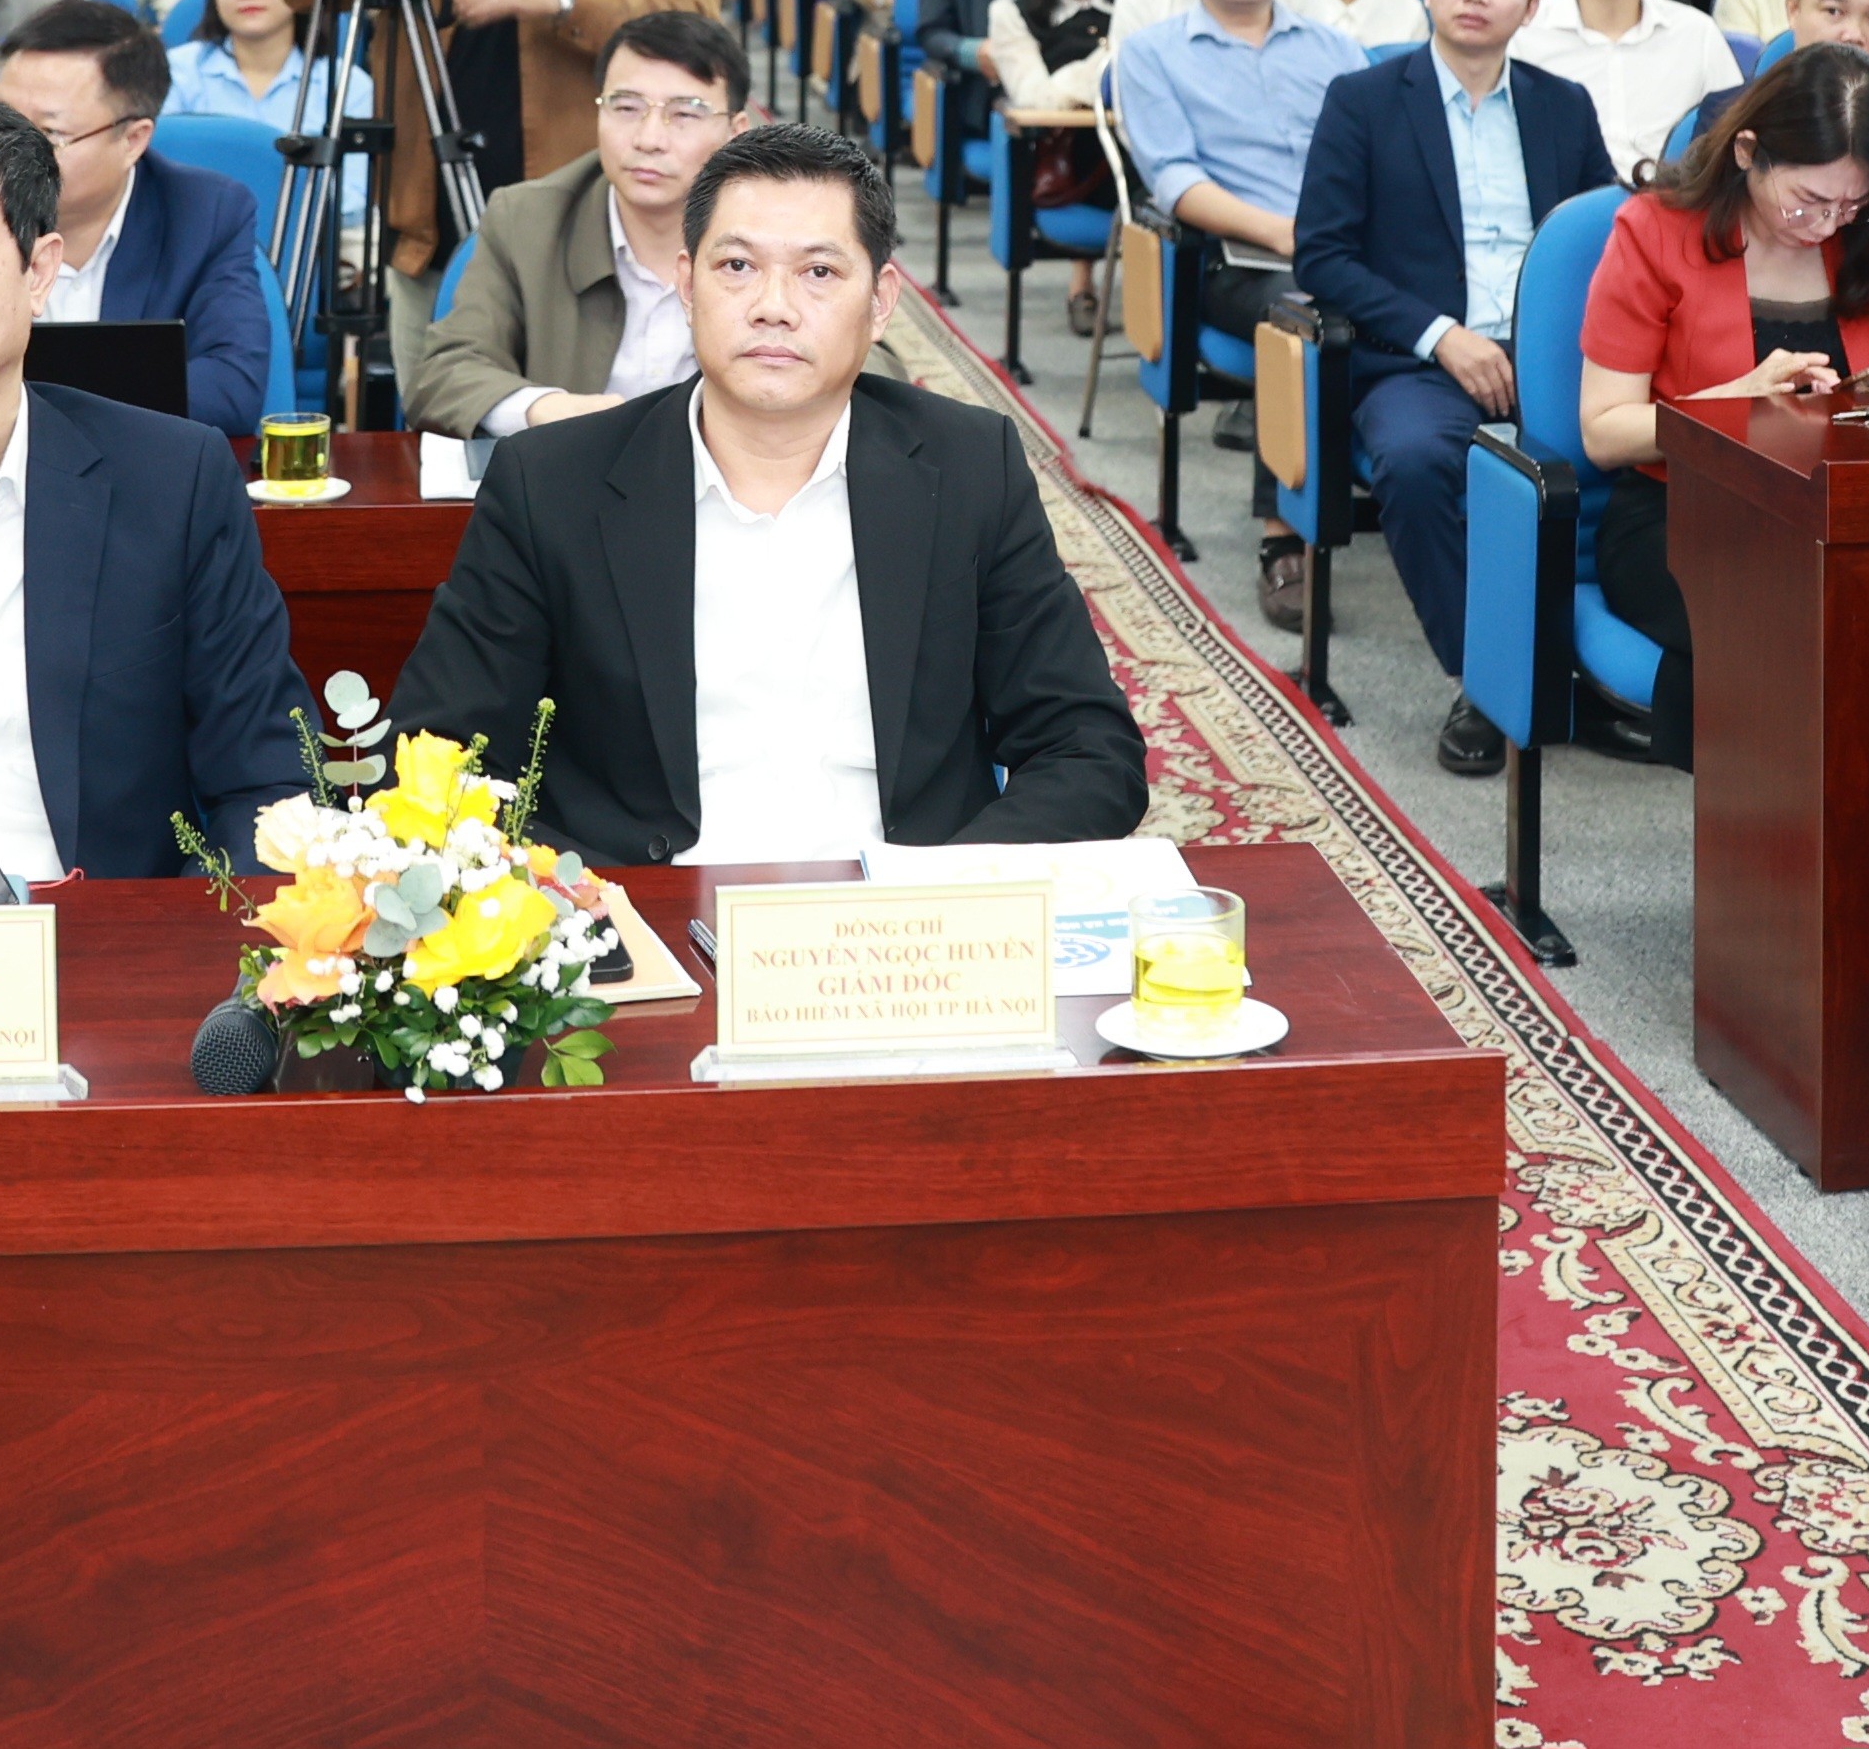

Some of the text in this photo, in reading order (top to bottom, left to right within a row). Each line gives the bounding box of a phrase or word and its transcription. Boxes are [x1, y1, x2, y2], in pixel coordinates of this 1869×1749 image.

[866, 943, 941, 967] NGỌC
[817, 969, 892, 996] GIÁM
[935, 1001, 960, 1015] TP
[966, 995, 994, 1015] HÀ
[0, 1028, 37, 1049] NỘI
